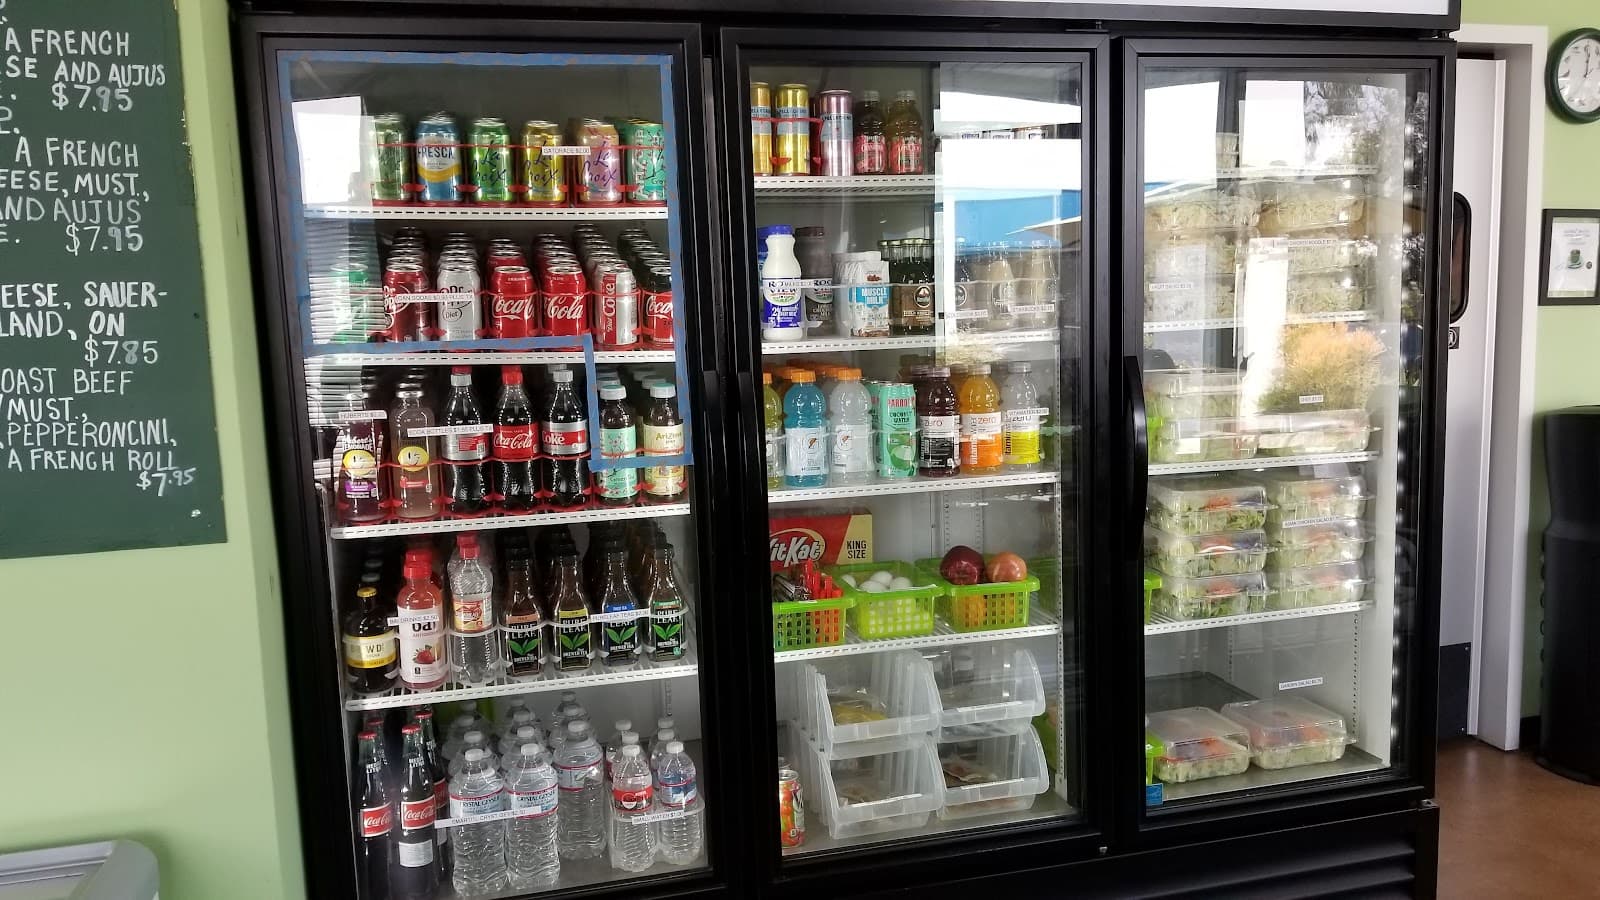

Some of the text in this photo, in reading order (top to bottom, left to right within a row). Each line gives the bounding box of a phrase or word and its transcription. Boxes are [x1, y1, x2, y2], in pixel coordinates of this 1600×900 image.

[5, 27, 130, 56] A FRENCH
[0, 55, 167, 88] SE AND AUJUS
[52, 81, 133, 112] $7.95
[15, 136, 139, 168] A FRENCH
[0, 195, 142, 224] ND AUJUS
[66, 222, 144, 256] $7.95
[84, 281, 168, 309] SAUER-
[861, 288, 887, 297] MUSCLE
[88, 310, 125, 337] ON
[84, 334, 158, 367] $7.85
[74, 370, 134, 396] BEEF
[7, 418, 177, 448] PEPPERONCINI,
[978, 416, 997, 425] zero
[494, 433, 532, 450] Coca-Cola
[8, 448, 180, 473] A FRENCH ROLL
[136, 467, 196, 497] $7.95
[846, 540, 867, 549] KING
[847, 550, 867, 559] SIZE
